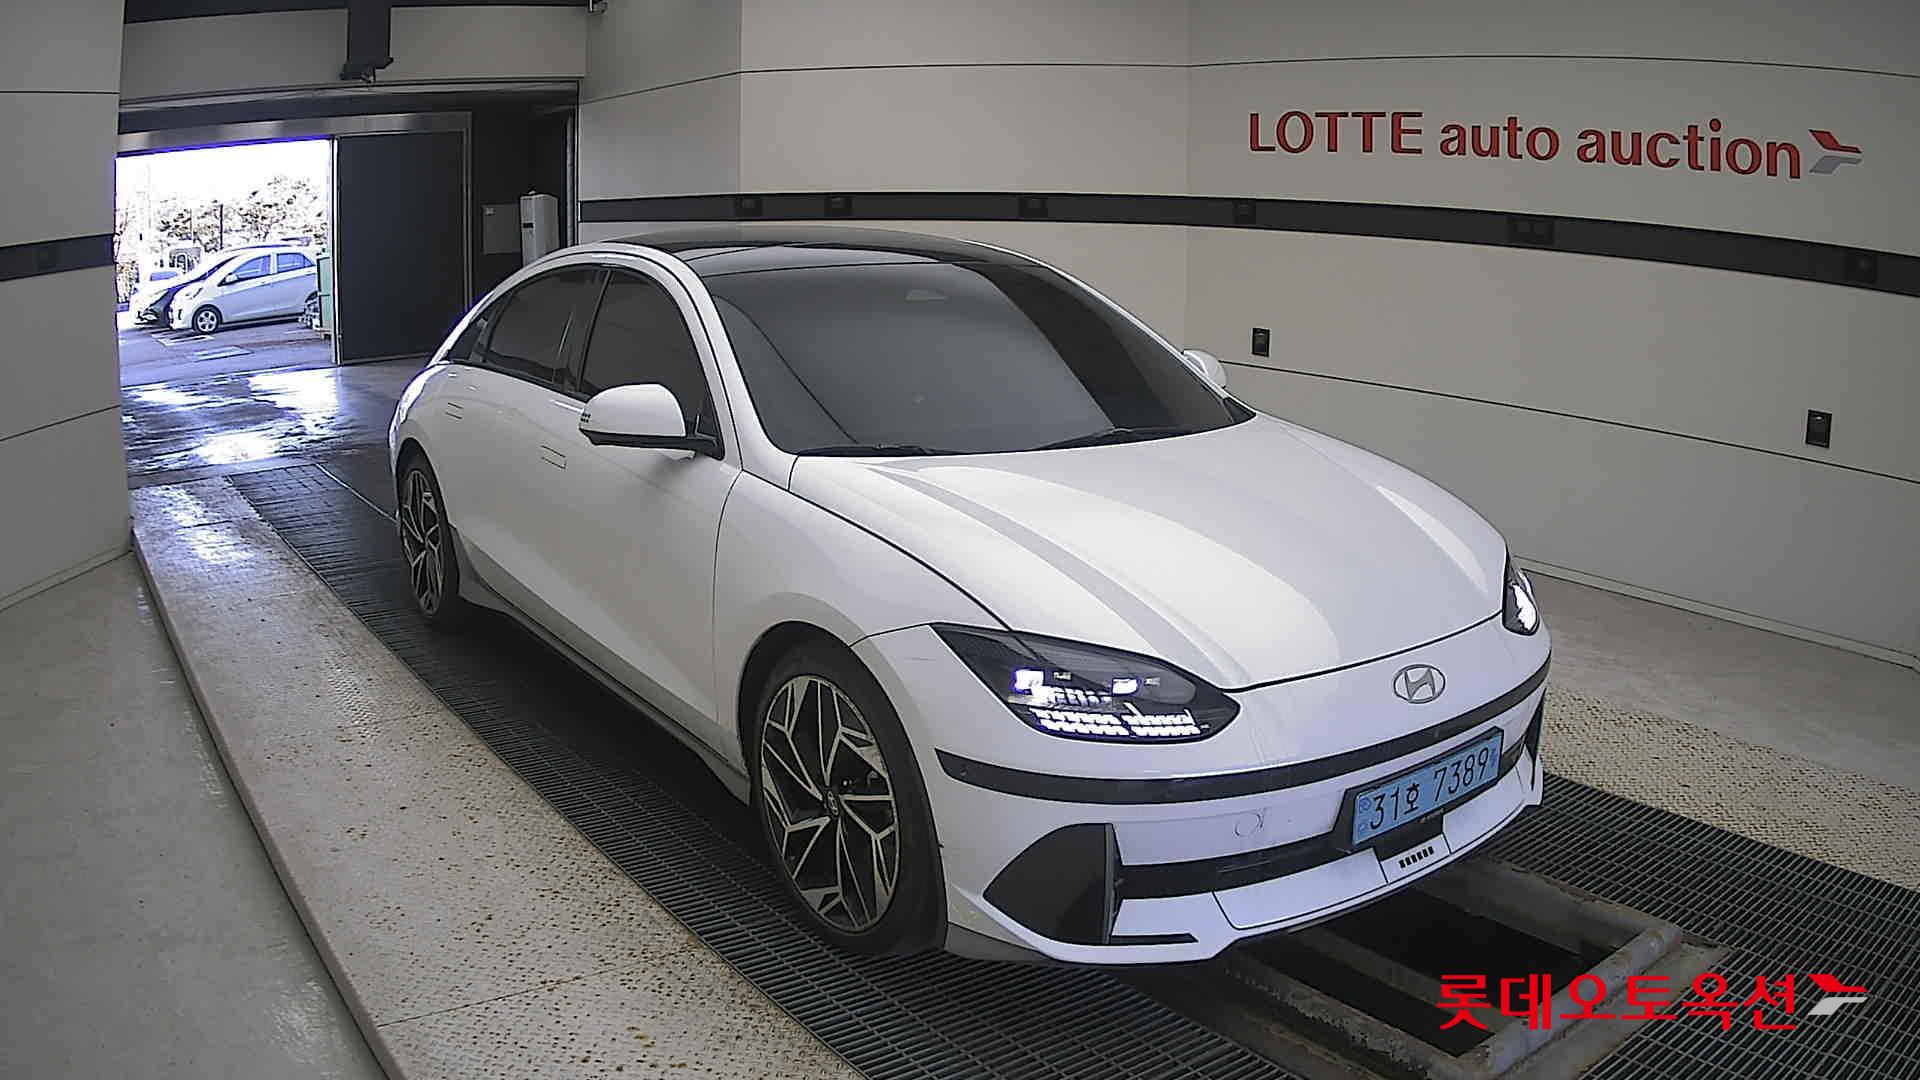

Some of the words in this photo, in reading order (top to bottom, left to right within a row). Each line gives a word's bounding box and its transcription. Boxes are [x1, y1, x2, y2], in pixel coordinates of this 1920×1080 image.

[1249, 112, 1423, 154] LOTTE
[1439, 116, 1560, 161] auto
[1576, 118, 1801, 179] auction
[1370, 783, 1420, 830] 31호
[1434, 747, 1489, 802] 7389
